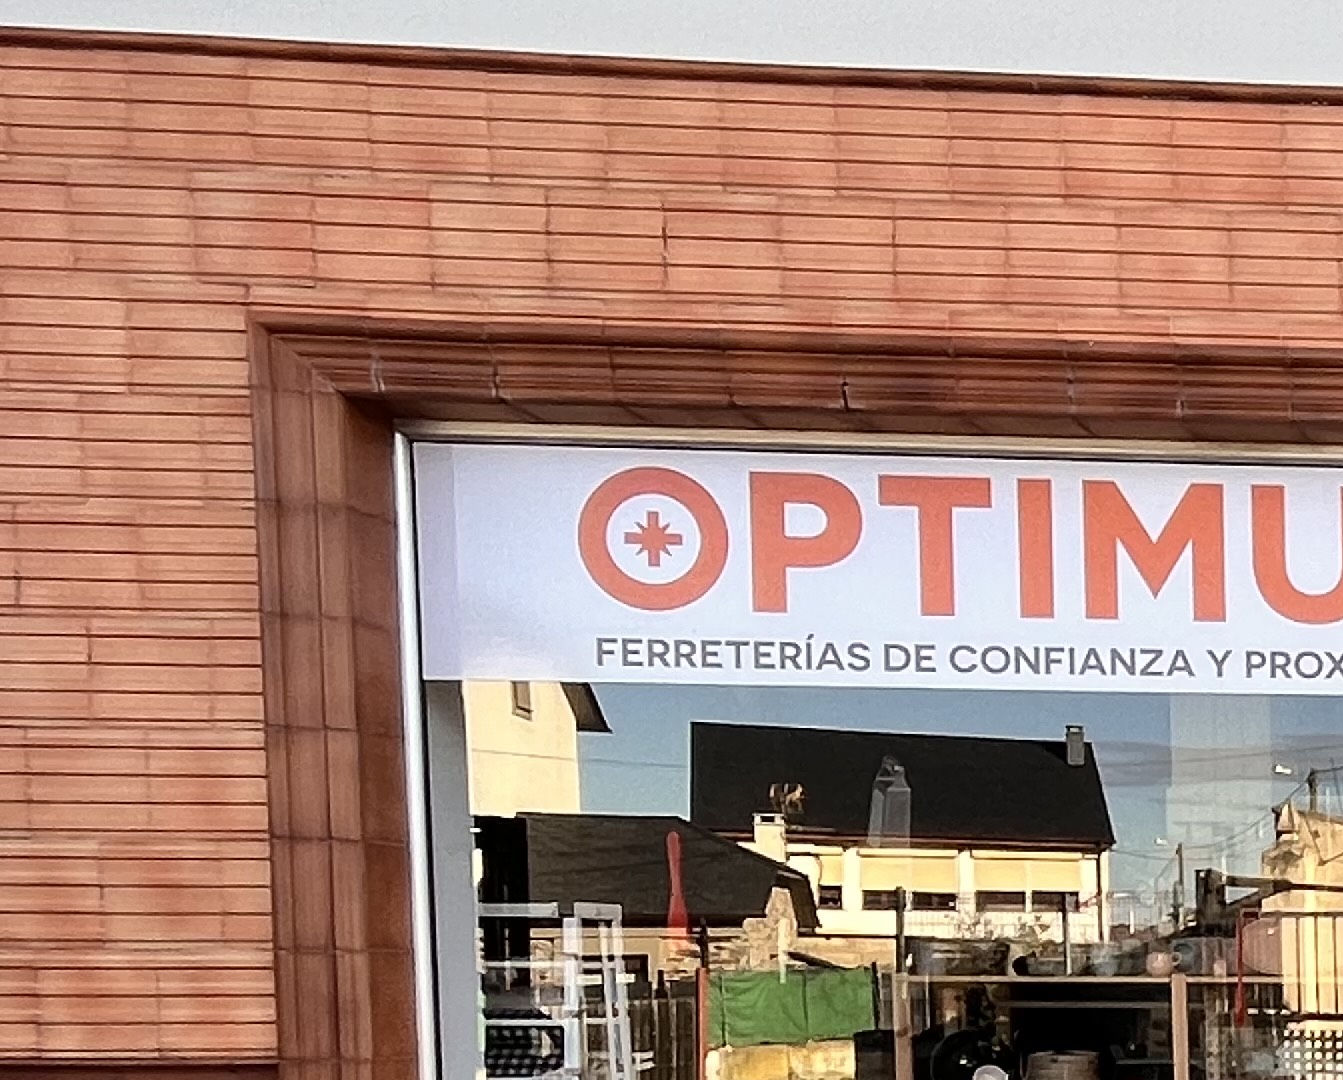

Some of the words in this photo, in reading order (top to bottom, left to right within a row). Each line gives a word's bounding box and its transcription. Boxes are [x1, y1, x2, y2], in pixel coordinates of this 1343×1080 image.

[595, 632, 871, 673] FERRETERÍAS
[883, 643, 937, 673] DE
[948, 645, 1196, 677] CONFIANZA
[1206, 649, 1233, 678] Y
